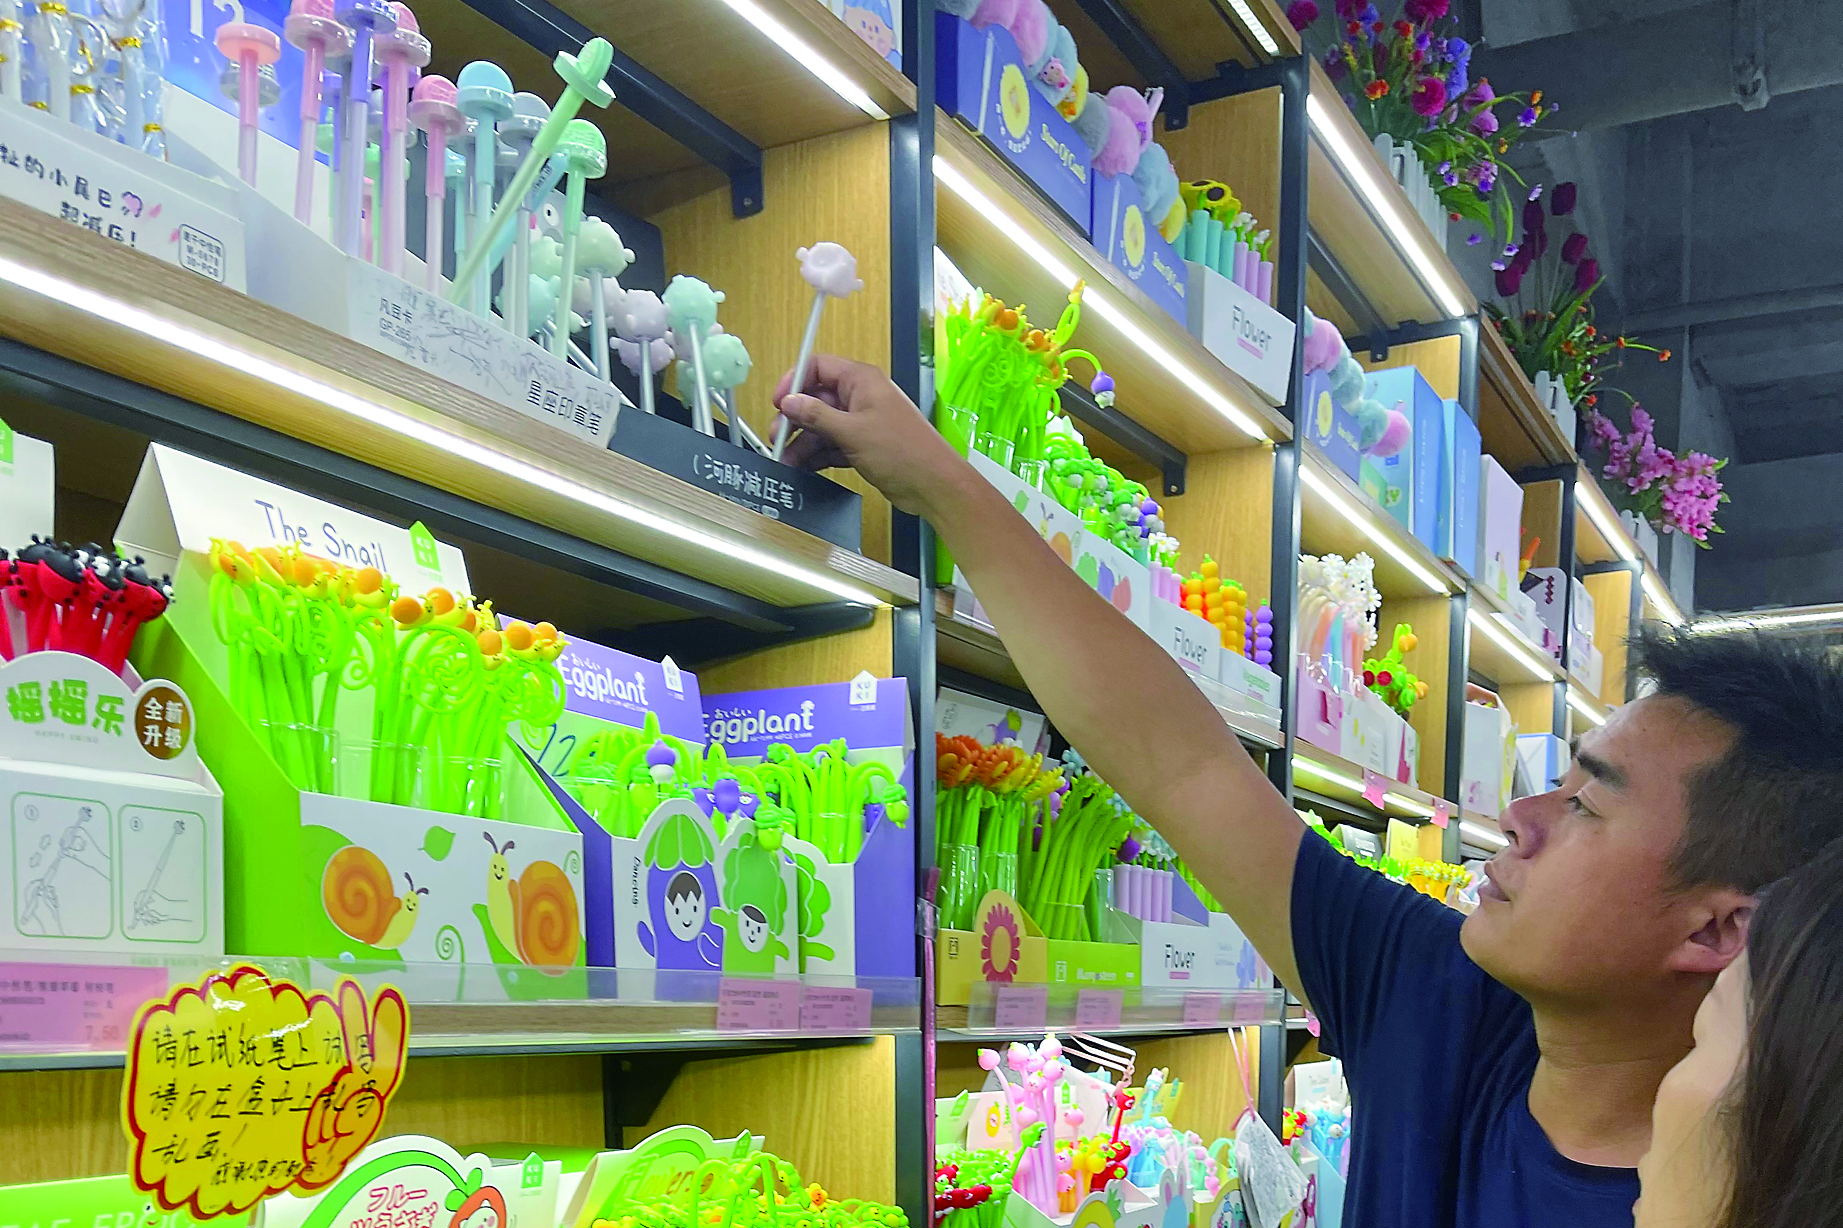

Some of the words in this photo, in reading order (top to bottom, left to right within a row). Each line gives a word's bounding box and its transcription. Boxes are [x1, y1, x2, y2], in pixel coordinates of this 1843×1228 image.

[254, 499, 311, 548] The
[322, 520, 388, 573] Snail
[5, 678, 126, 738] 摇摇乐
[143, 696, 184, 725] 全新
[143, 724, 183, 750] 升级
[1164, 943, 1195, 970] Flower
